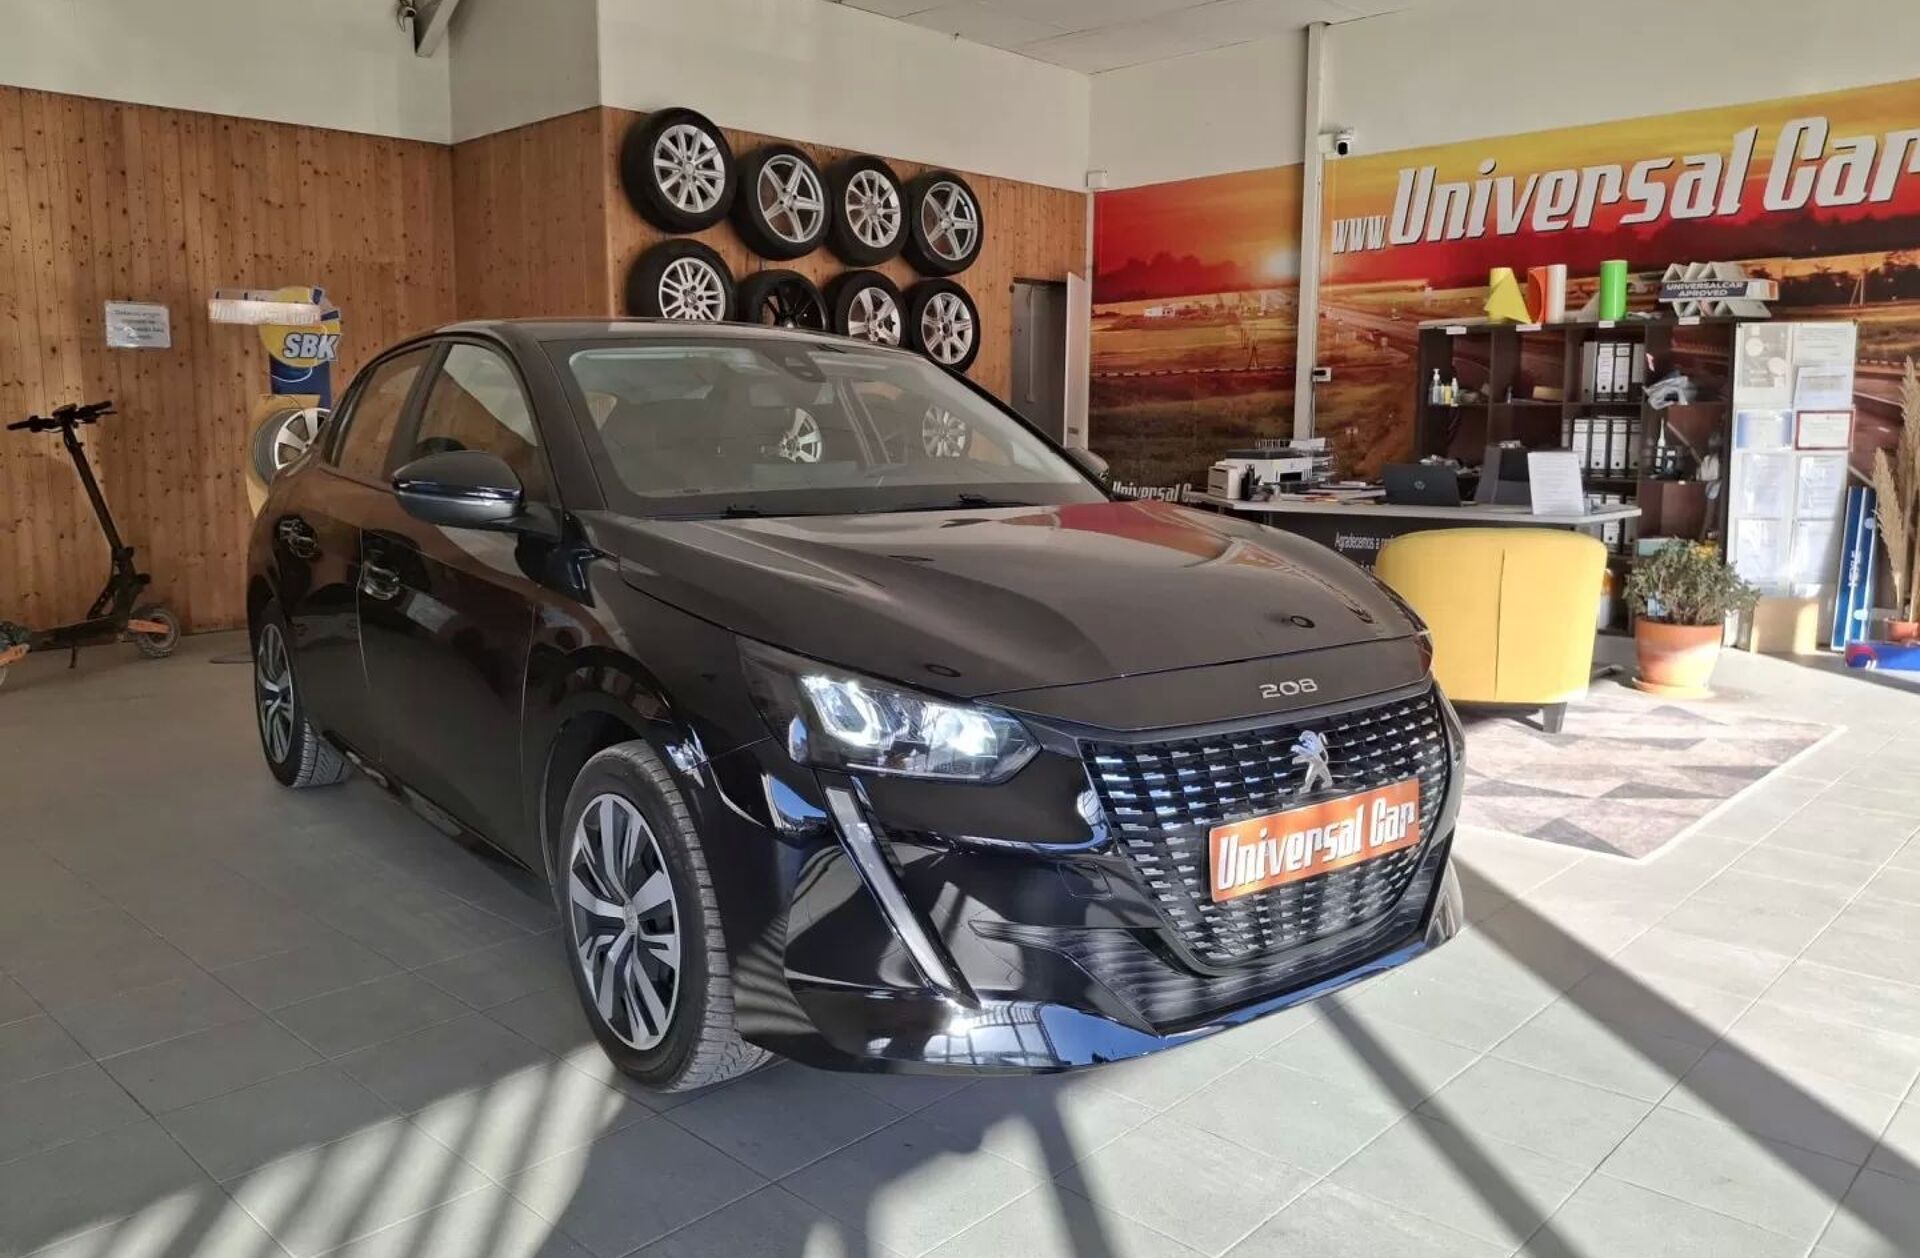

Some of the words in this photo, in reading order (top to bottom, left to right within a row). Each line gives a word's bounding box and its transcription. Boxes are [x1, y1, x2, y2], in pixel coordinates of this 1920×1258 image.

[1389, 124, 1758, 246] Universal
[1763, 115, 1920, 212] Car
[1665, 281, 1744, 291] UNIVERSALCAR
[283, 332, 340, 361] SBK
[1112, 480, 1181, 502] Universal
[1258, 678, 1318, 699] 208
[1217, 804, 1365, 891] Universal
[1369, 797, 1416, 848] Car
